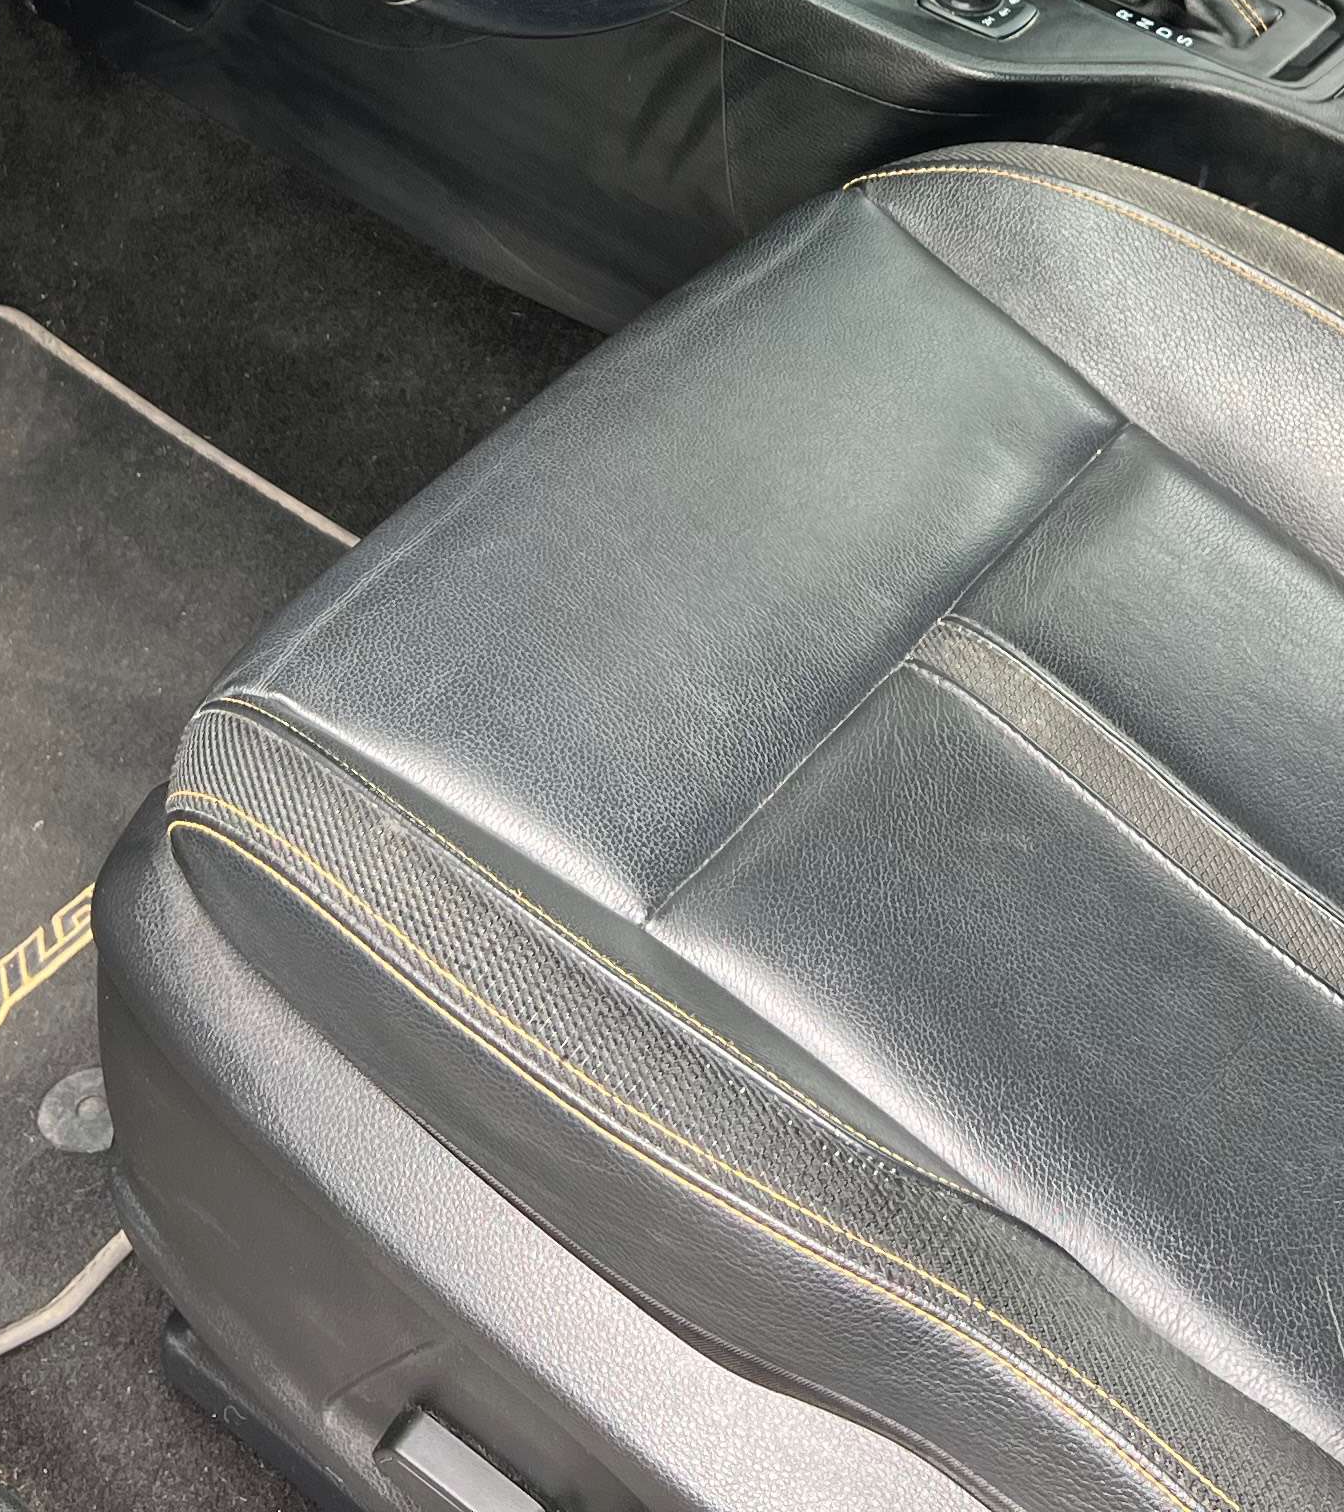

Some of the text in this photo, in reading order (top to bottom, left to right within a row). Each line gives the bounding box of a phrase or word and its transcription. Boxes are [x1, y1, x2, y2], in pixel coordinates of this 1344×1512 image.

[1115, 9, 1134, 22] R
[1136, 18, 1155, 30] N
[1156, 26, 1173, 39] D
[1176, 34, 1193, 48] S
